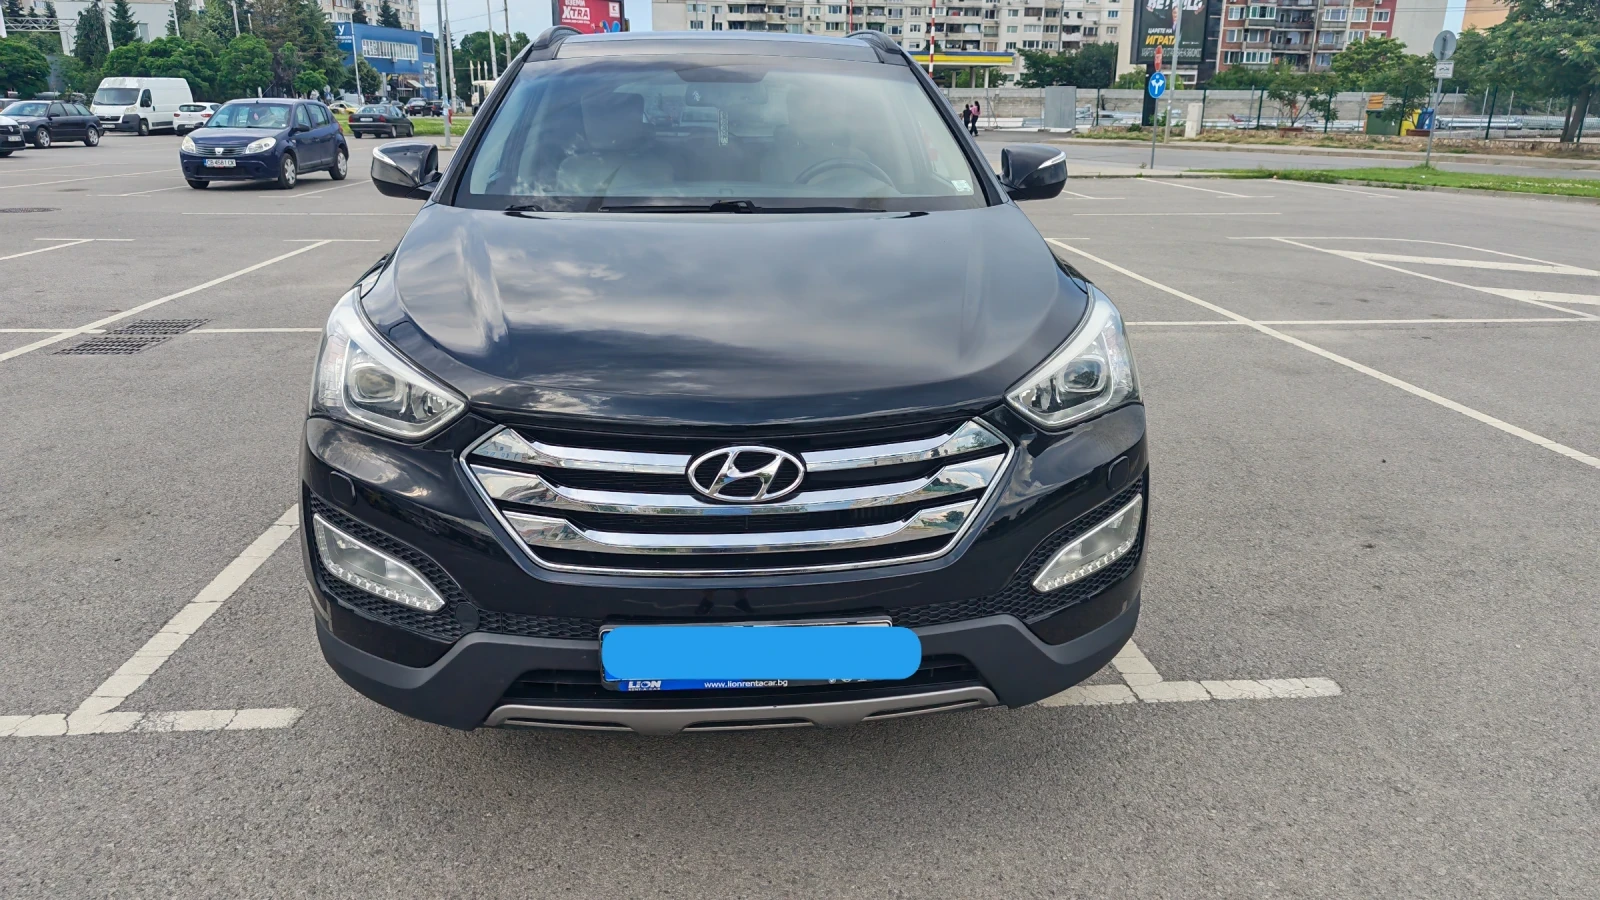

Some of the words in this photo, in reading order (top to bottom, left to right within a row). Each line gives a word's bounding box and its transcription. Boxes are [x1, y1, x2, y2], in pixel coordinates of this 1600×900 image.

[562, 6, 590, 19] XTRA
[628, 680, 662, 688] LION
[704, 679, 788, 688] www.lionrentacar.bg
